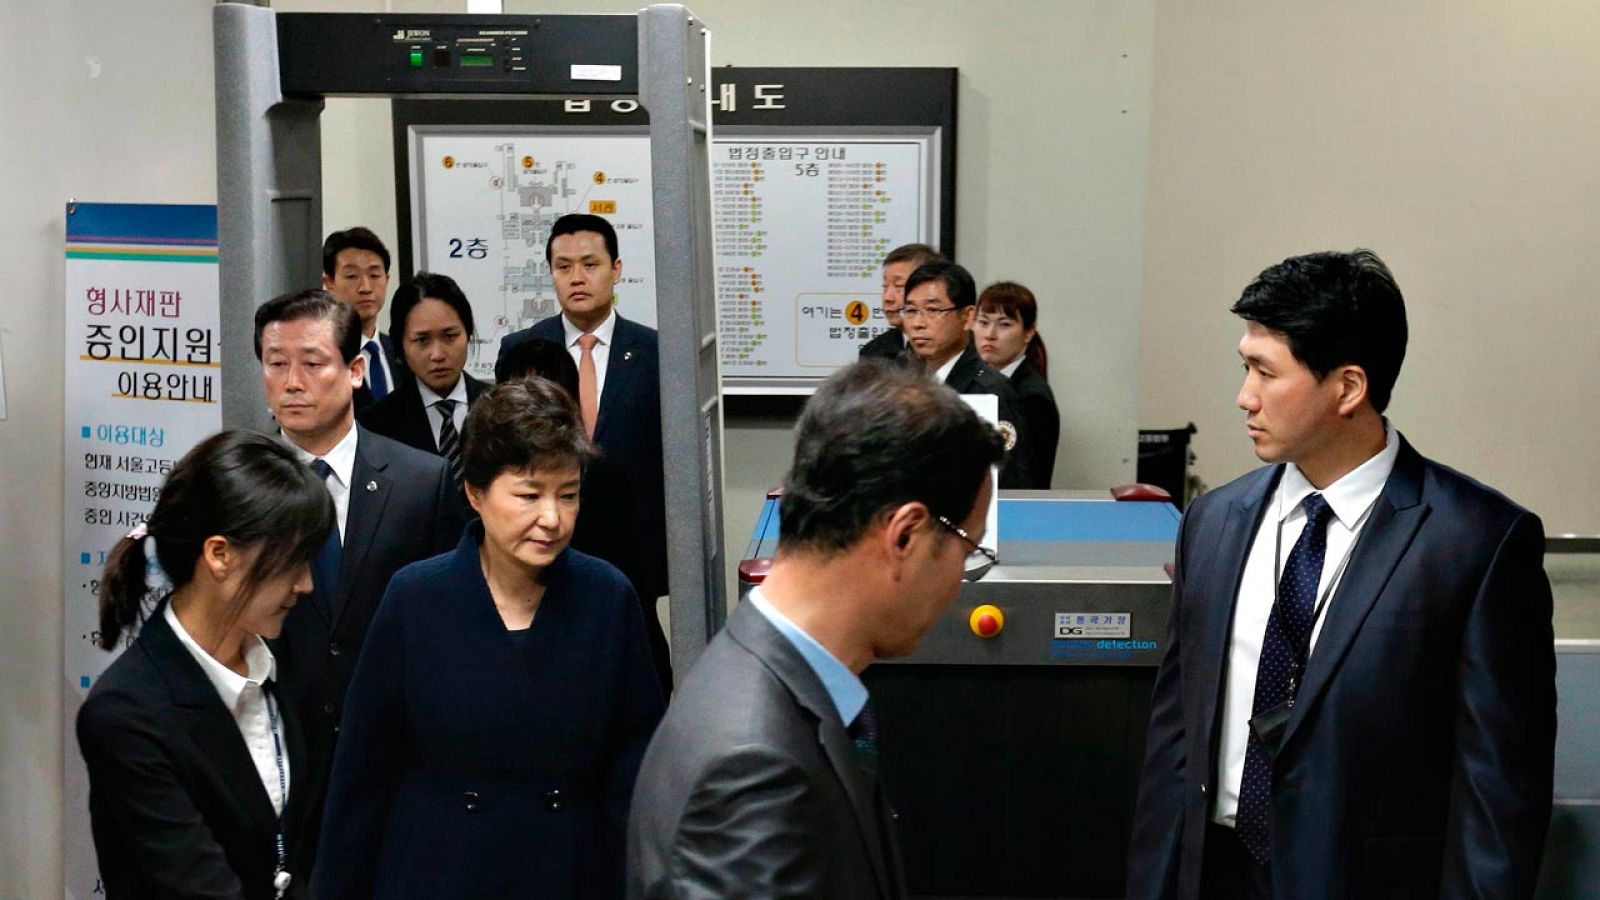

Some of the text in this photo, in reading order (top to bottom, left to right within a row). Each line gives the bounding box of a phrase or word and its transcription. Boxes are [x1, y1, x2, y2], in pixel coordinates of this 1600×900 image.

[729, 147, 846, 160] 법정출입구 안내
[795, 163, 819, 177] 5층
[449, 238, 489, 259] 2층
[86, 287, 182, 318] 형사재판
[802, 307, 841, 319] 여기는
[85, 324, 221, 365] 증인지원
[118, 371, 213, 403] 이용안내
[97, 424, 165, 448] 이용대상
[85, 452, 177, 475] 현재 서울고등
[1096, 639, 1157, 650] detection
